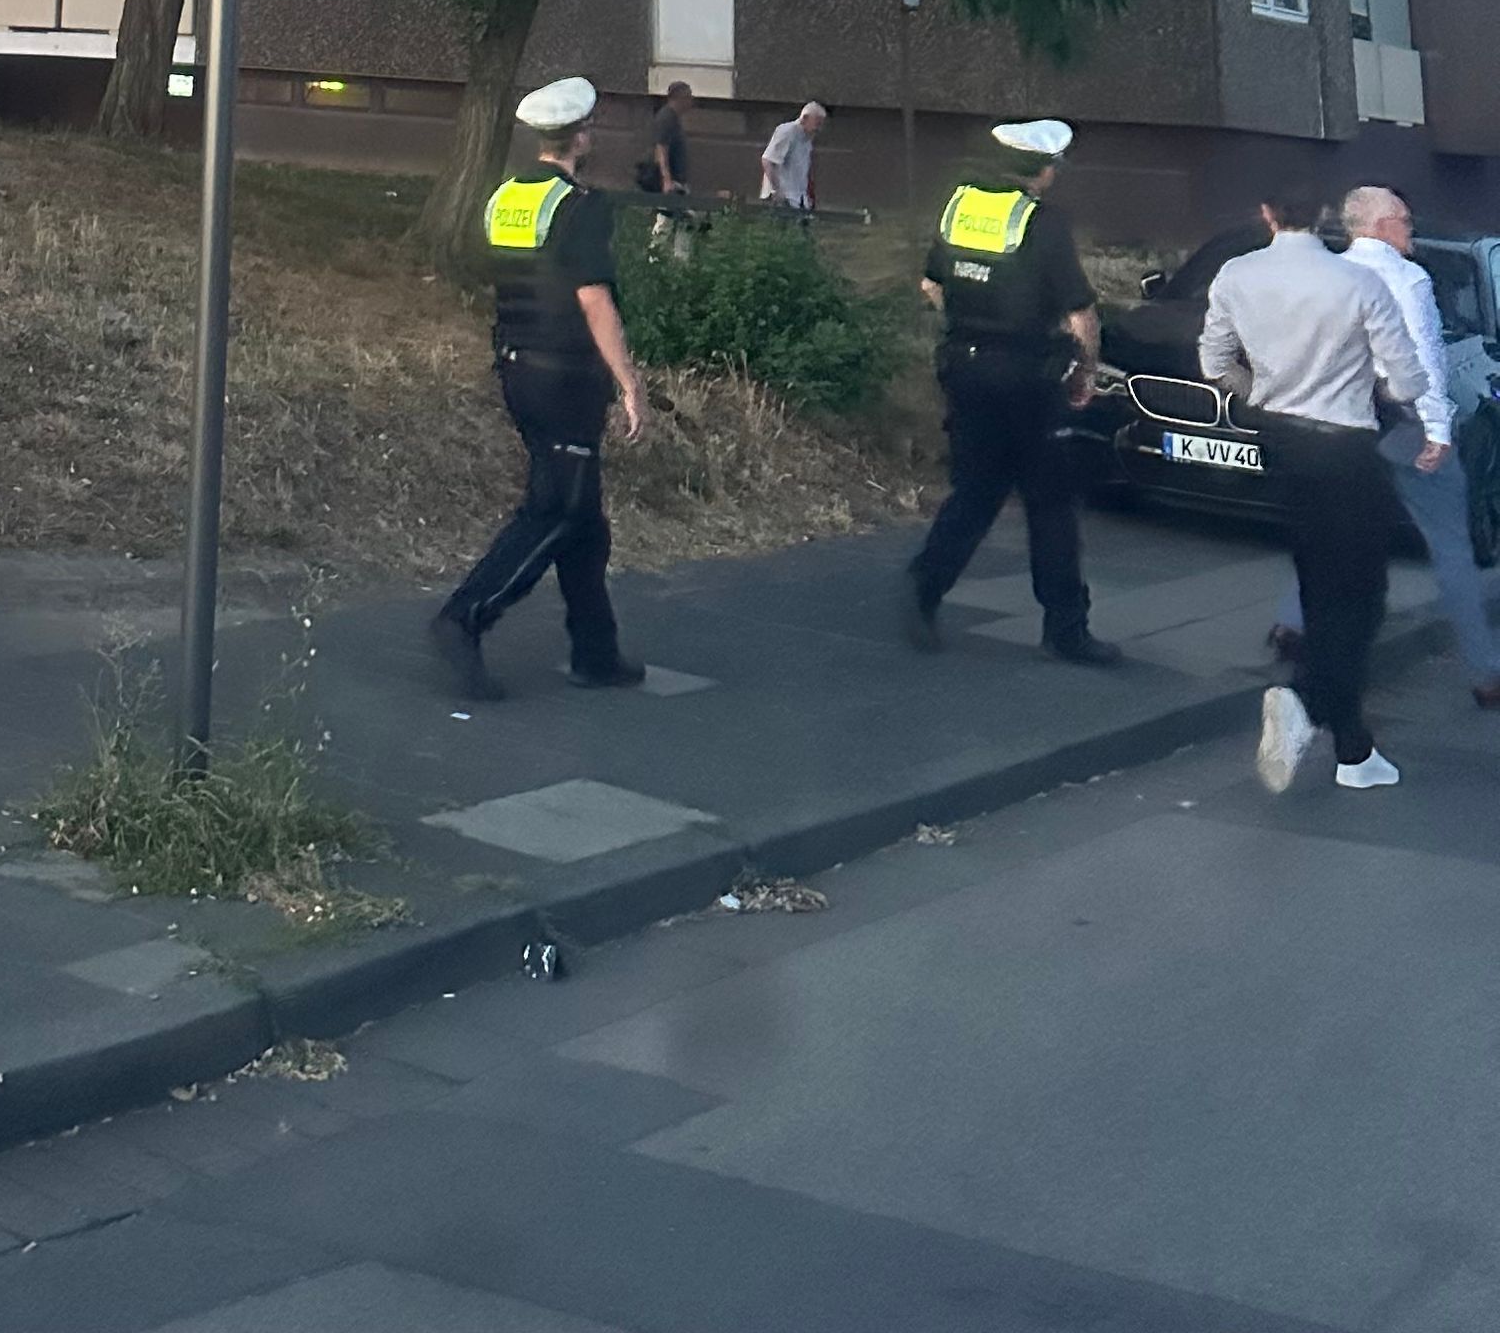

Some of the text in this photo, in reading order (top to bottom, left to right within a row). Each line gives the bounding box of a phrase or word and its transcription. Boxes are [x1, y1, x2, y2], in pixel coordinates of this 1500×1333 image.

[495, 208, 534, 228] POLIZEI
[958, 213, 1003, 235] POLIZEI
[1182, 438, 1264, 468] K VV 40
